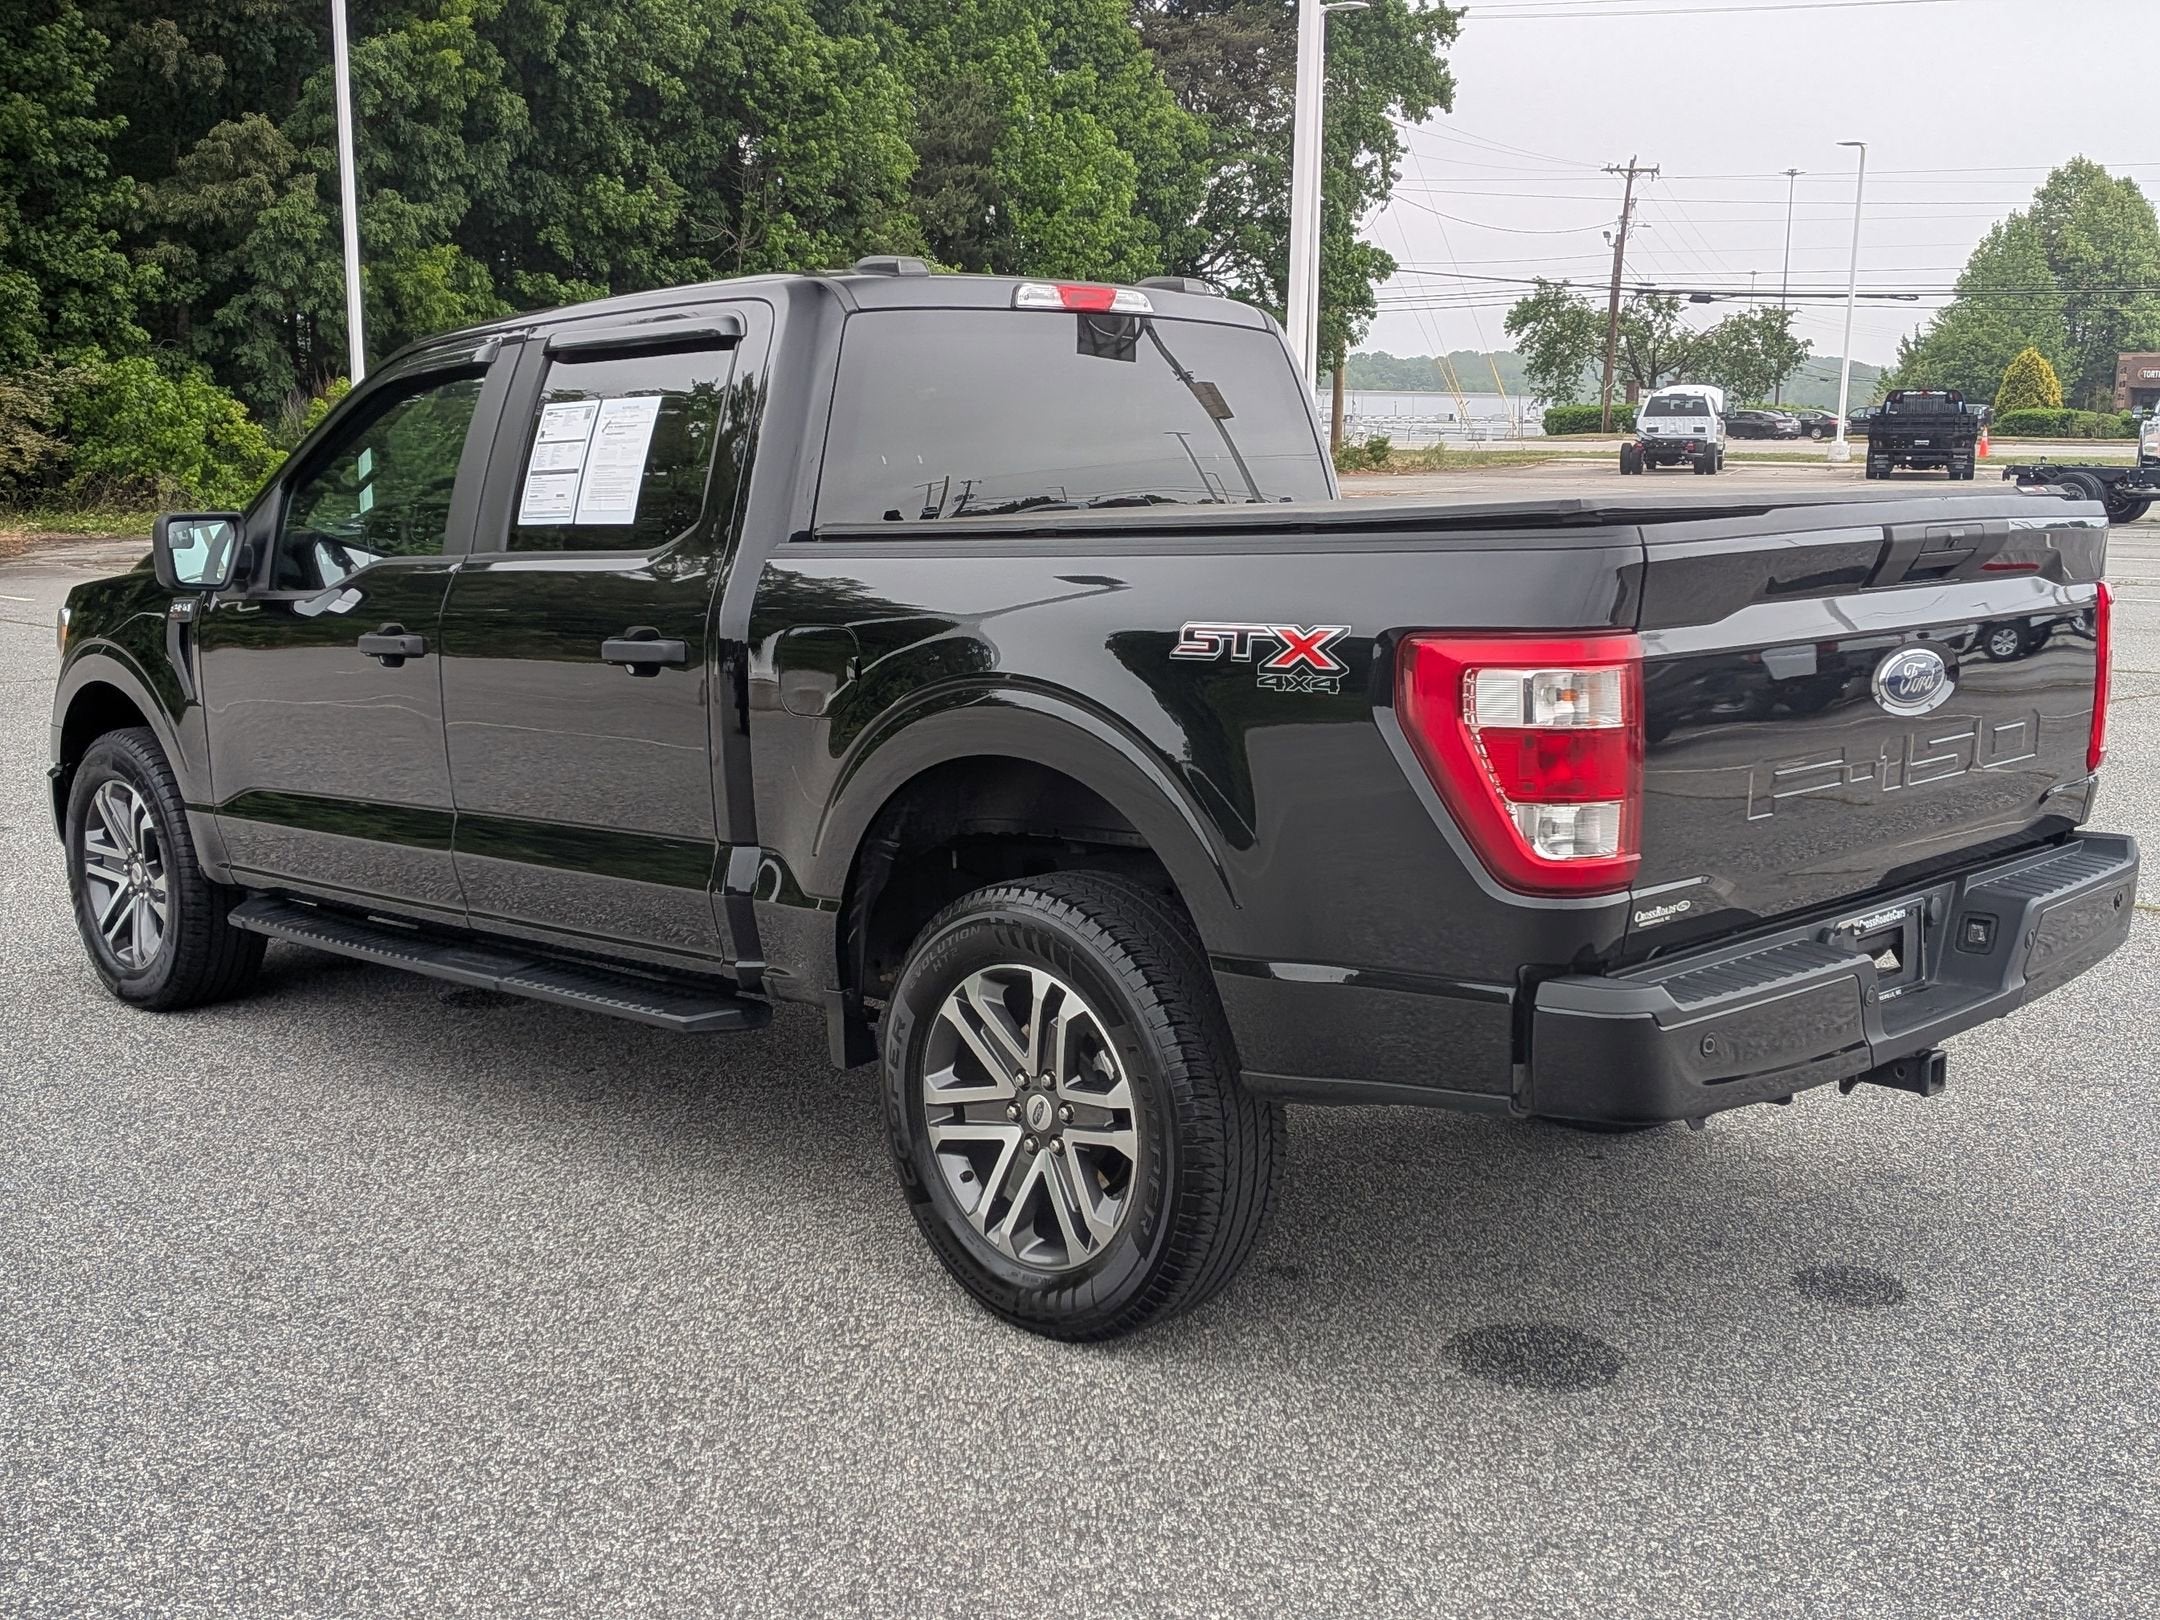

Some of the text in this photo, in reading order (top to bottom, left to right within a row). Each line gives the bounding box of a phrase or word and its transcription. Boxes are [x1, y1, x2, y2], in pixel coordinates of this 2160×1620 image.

[1169, 621, 1351, 678] STX
[1899, 662, 1935, 695] Ford
[1747, 709, 2041, 820] F-150
[909, 925, 981, 989] EVOLUTION
